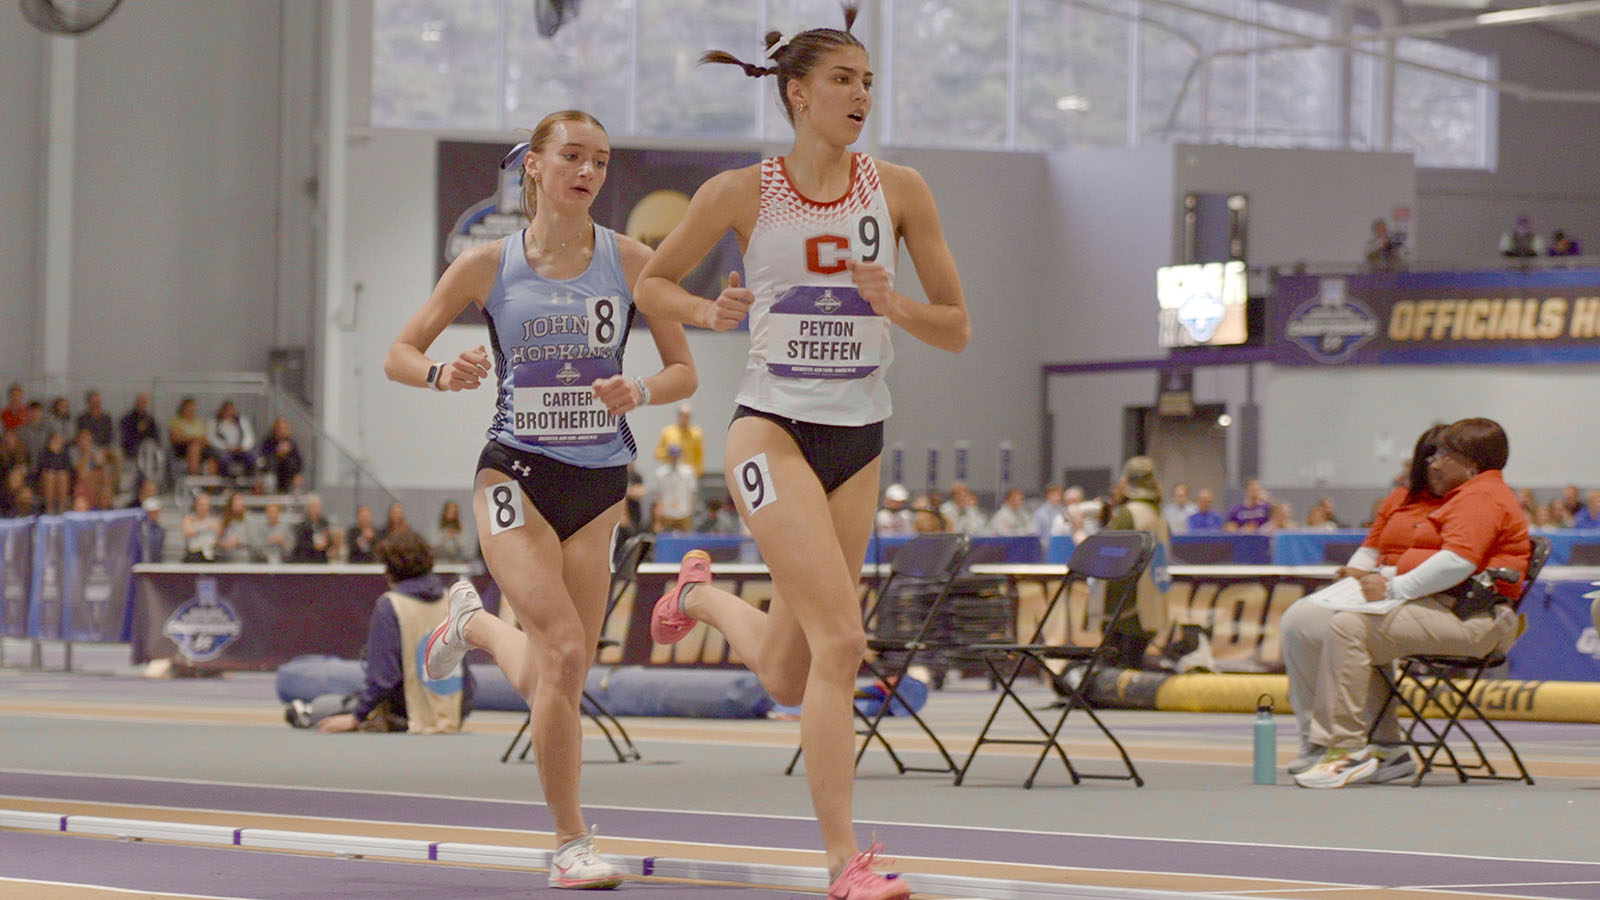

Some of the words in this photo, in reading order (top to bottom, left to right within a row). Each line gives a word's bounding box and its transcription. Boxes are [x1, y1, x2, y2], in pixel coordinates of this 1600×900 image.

[805, 234, 849, 275] C
[858, 215, 880, 262] 9
[522, 315, 590, 342] JOHN
[595, 300, 615, 344] 8
[800, 321, 854, 337] PEYTON
[1388, 300, 1569, 341] OFFICIALS
[1569, 298, 1600, 338] H
[787, 340, 862, 361] STEFFEN
[515, 410, 617, 430] BROTHERTON
[543, 392, 593, 407] CARTER
[742, 461, 765, 509] 9
[492, 486, 516, 528] 8
